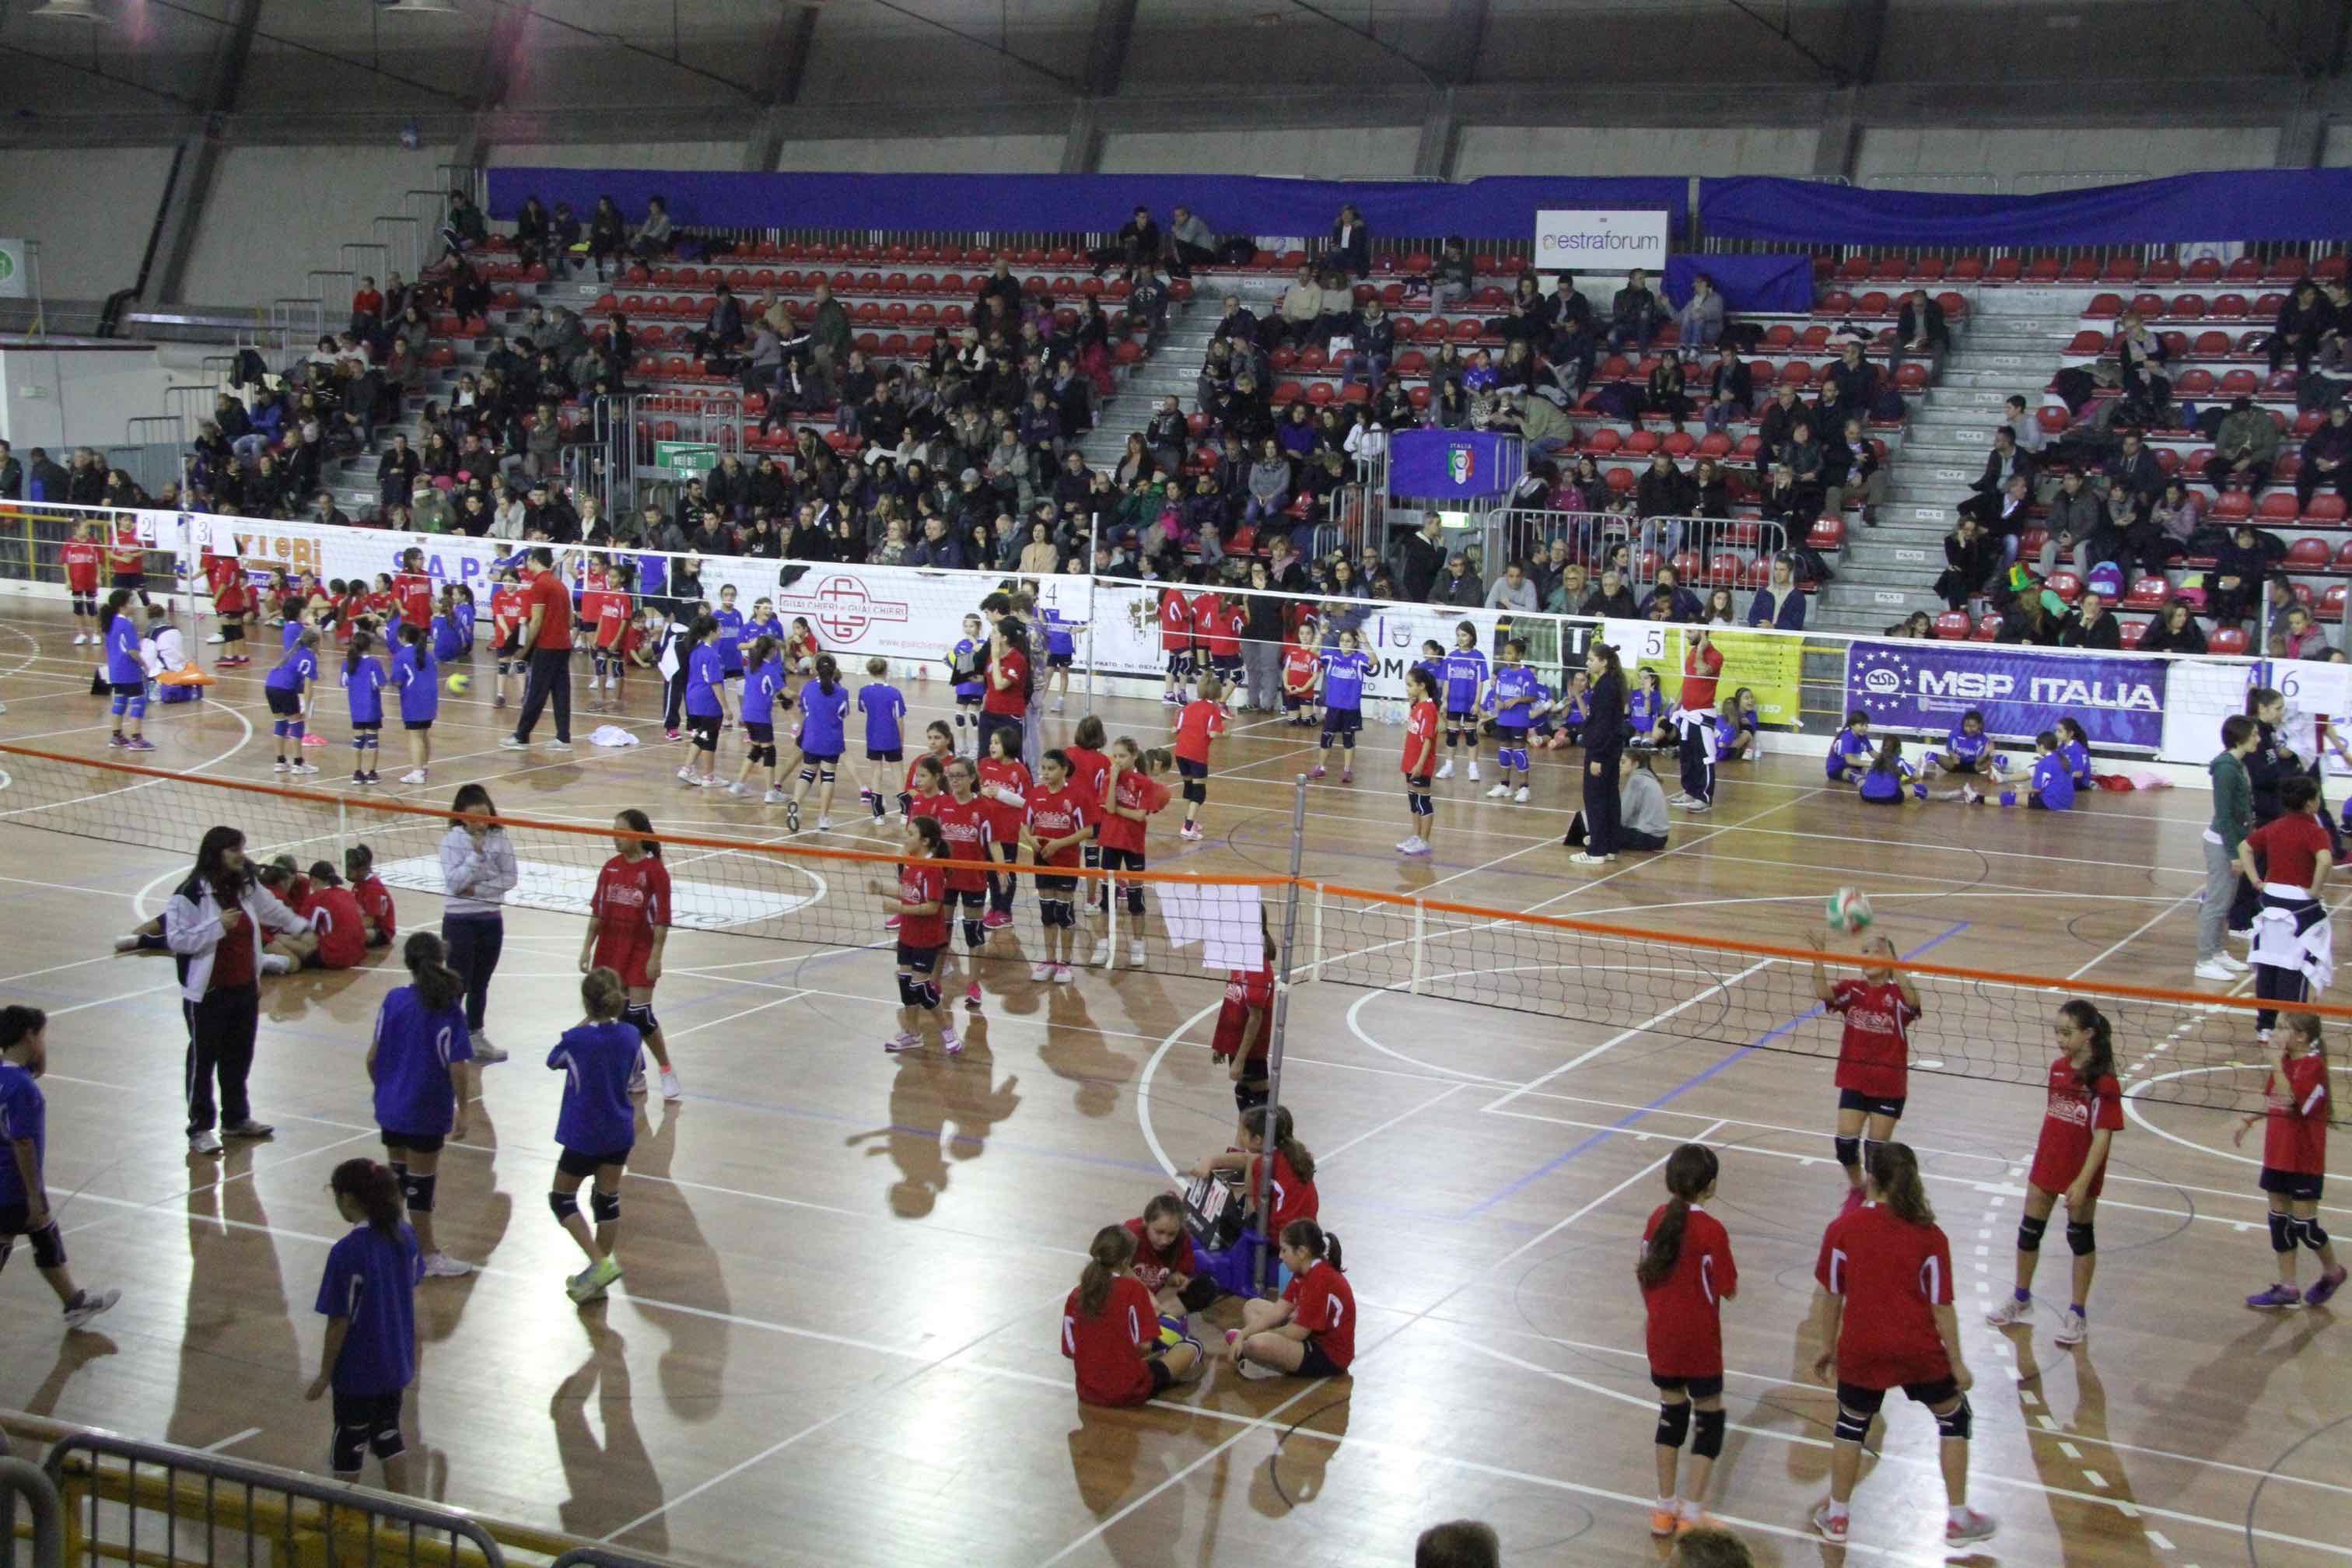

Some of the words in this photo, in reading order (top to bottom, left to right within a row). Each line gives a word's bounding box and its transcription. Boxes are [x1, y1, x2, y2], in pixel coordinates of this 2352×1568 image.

[1557, 230, 1659, 250] estraforum
[142, 516, 152, 537] 2
[197, 521, 208, 542] 3
[1045, 583, 1058, 606] 4
[1646, 630, 1661, 656] 5
[1918, 669, 2015, 698] MSP
[2029, 677, 2160, 710] ITALIA
[2281, 670, 2300, 698] 6
